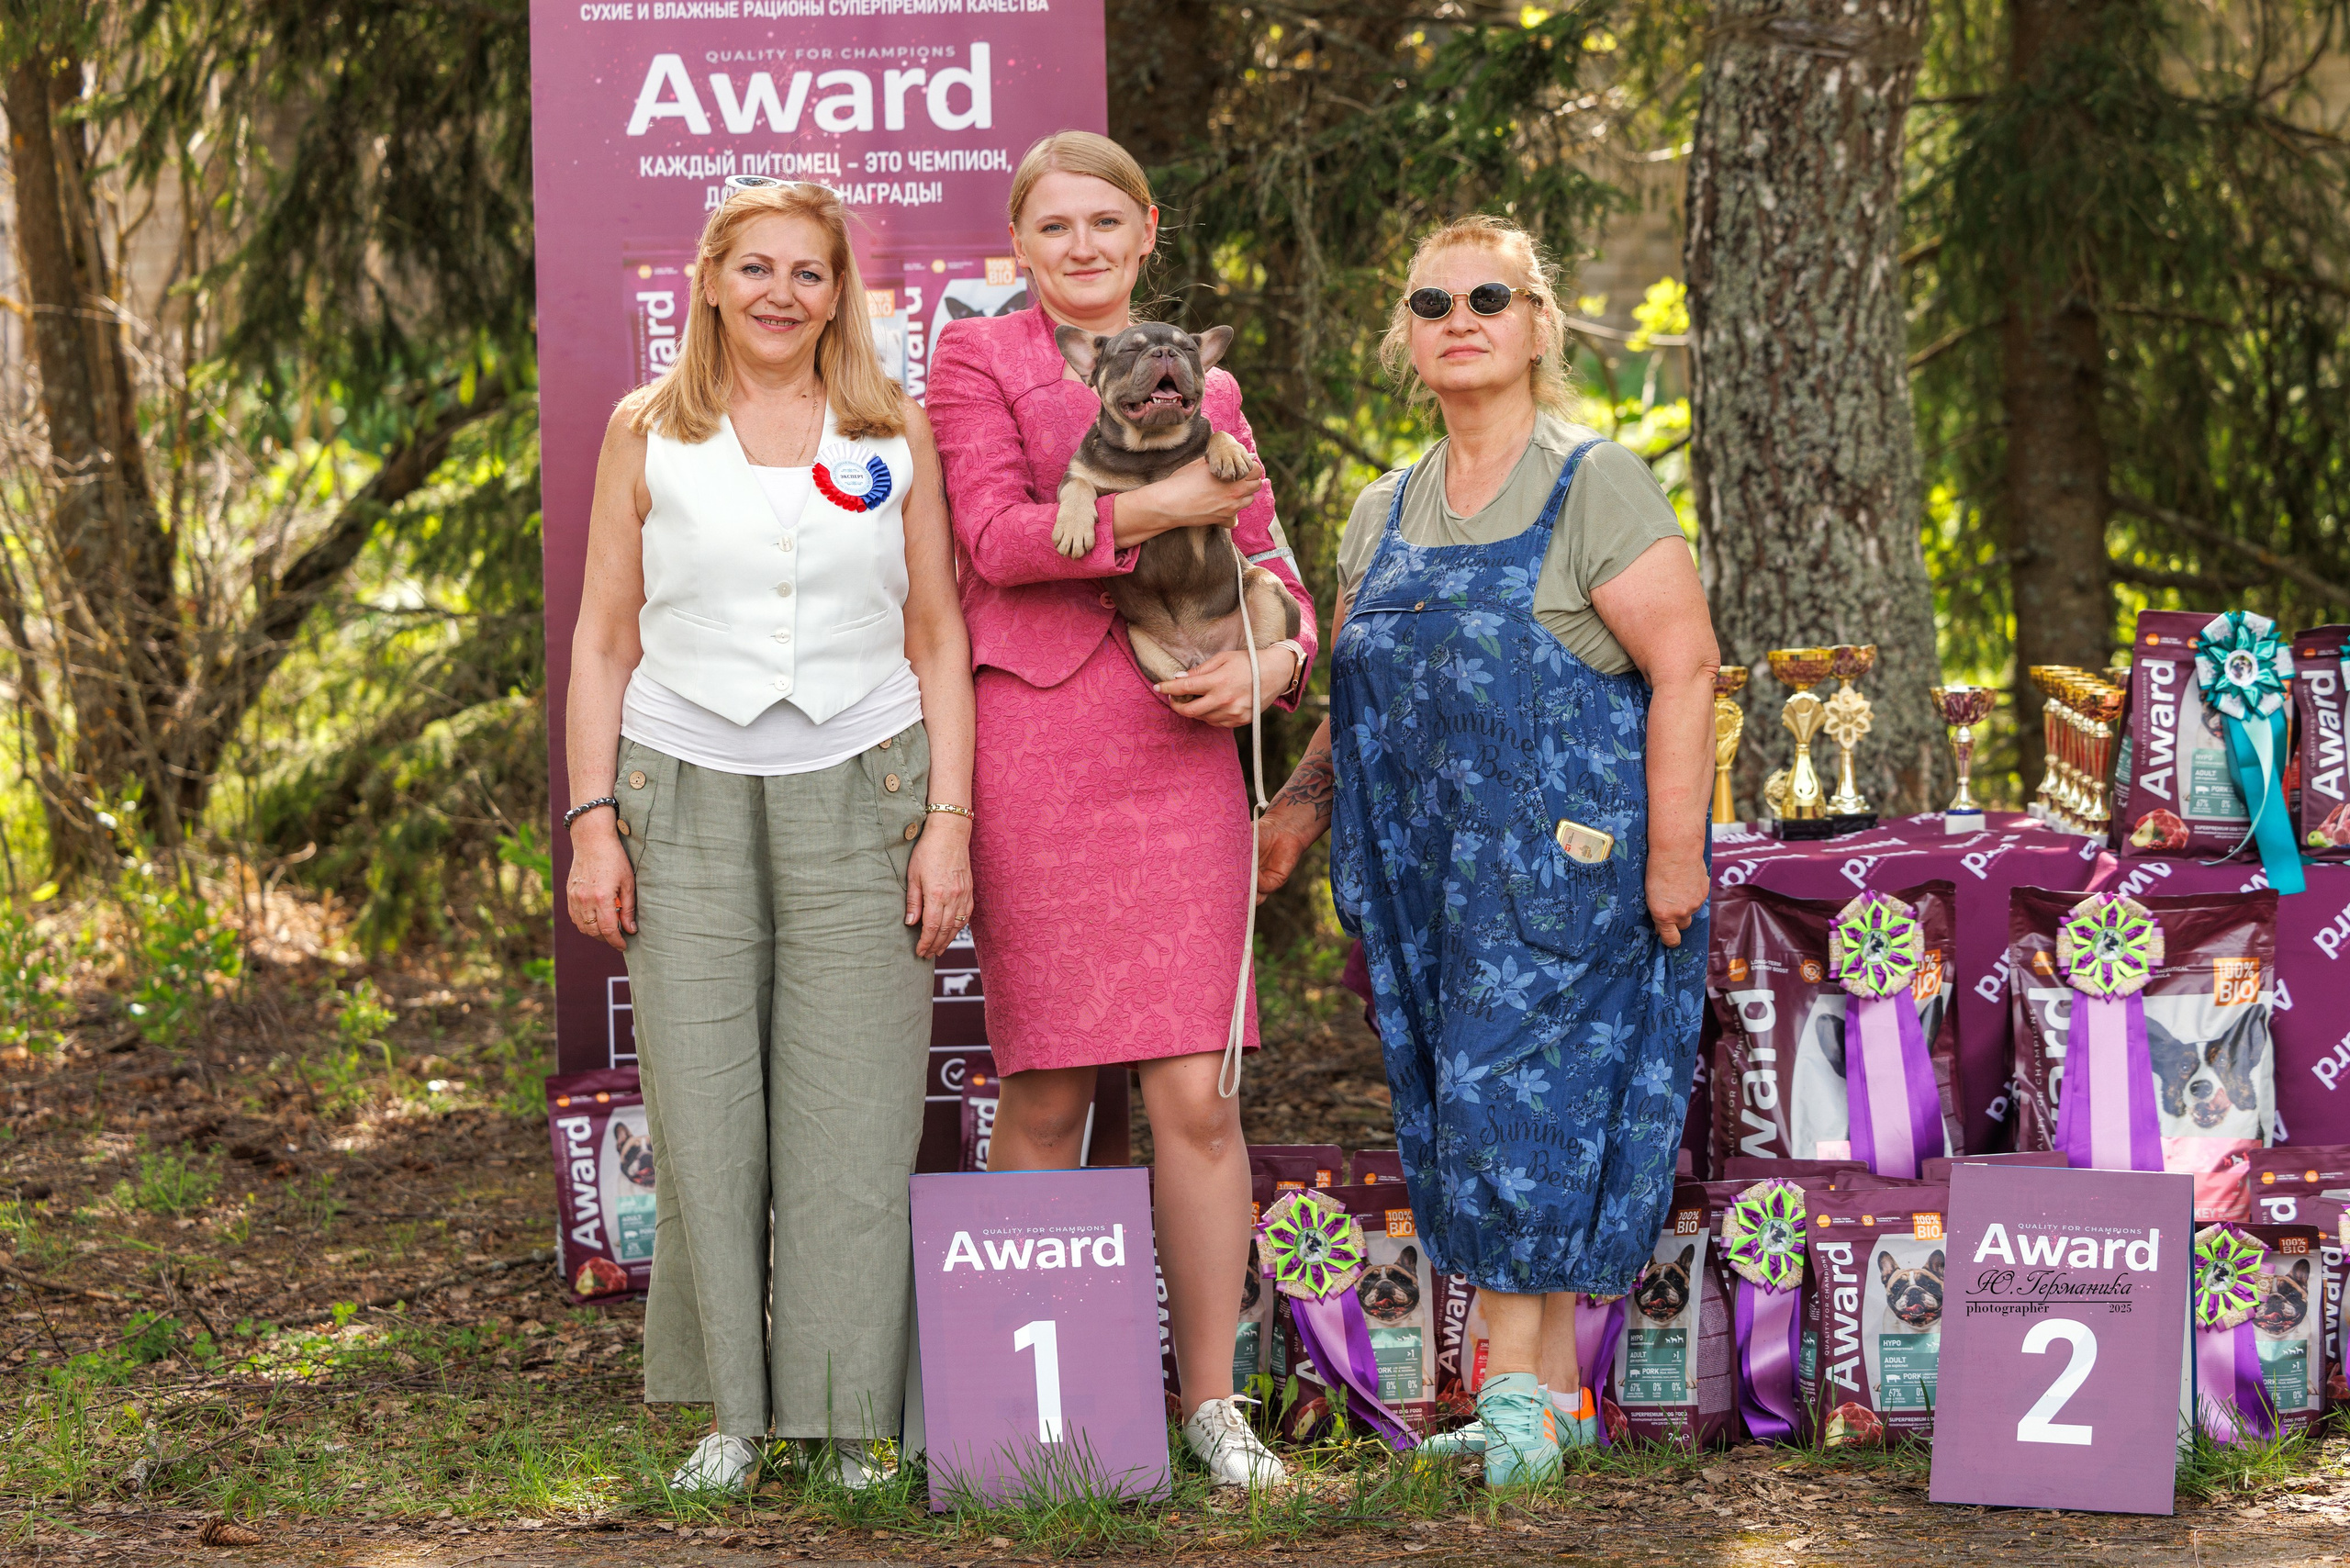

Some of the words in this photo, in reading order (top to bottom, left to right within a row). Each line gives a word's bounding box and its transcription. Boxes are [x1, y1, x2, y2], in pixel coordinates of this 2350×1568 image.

[580, 3, 633, 21] СУХИЕ
[638, 2, 650, 20] И
[653, 1, 740, 19] ВЛАЖНЫЕ
[744, 0, 825, 20] РАЦИОНЫ
[828, 0, 963, 17] СУПЕРПРЕМИУМ
[967, 0, 1050, 13] КАЧЕСТВА
[706, 50, 788, 63] QUALITY
[795, 48, 833, 61] FOR
[840, 45, 957, 60] CHAMPIONS
[626, 41, 992, 137] Award
[640, 150, 736, 180] КАЖДЫЙ
[742, 152, 841, 179] ПИТОМЕЦ
[865, 151, 902, 174] ЭТО
[907, 149, 1013, 174] ЧЕМПИОН,
[841, 182, 943, 207] НАГРАДЫ!
[989, 271, 1013, 284] BIO
[2139, 657, 2177, 801] Award
[2301, 669, 2344, 801] Award
[2217, 961, 2255, 980] 100%
[2219, 979, 2255, 1002] BIO
[2029, 1007, 2042, 1085] CHAMPIONS
[1726, 989, 1778, 1159] ward
[1729, 1090, 1737, 1115] FOR
[1479, 1103, 1587, 1159] Summer
[1728, 1121, 1736, 1158] ALITY
[2036, 1114, 2045, 1150] ALITY
[556, 1114, 603, 1250] Award
[1388, 1210, 1412, 1222] 100%
[1678, 1210, 1700, 1221] 100%
[1914, 1215, 1939, 1225] 100%
[2194, 1207, 2216, 1218] KEY
[1048, 1225, 1106, 1233] CHAMPIONS
[1389, 1221, 1413, 1235] BIO
[1676, 1220, 1697, 1234] BIO
[1917, 1225, 1941, 1238] BIO
[2018, 1223, 2058, 1231] QUALITY
[2084, 1226, 2143, 1235] CHAMPIONS
[942, 1223, 1126, 1272] Award
[1973, 1223, 2160, 1272] Award
[2281, 1238, 2306, 1247] 100%
[2282, 1246, 2307, 1254] BIO
[1820, 1255, 1830, 1300] CHAMPIONS
[1817, 1241, 1860, 1393] Award
[1629, 1350, 1647, 1359] ADULT
[1884, 1356, 1907, 1364] ADULT
[1013, 1320, 1064, 1443] 1
[1386, 1381, 1396, 1390] 0%
[1407, 1380, 1418, 1389] 0%
[1652, 1382, 1662, 1392] 0%
[1671, 1382, 1682, 1392] 0%
[2017, 1317, 2098, 1446] 2
[1888, 1388, 1902, 1397] 67%
[2292, 1389, 2303, 1399] 0%
